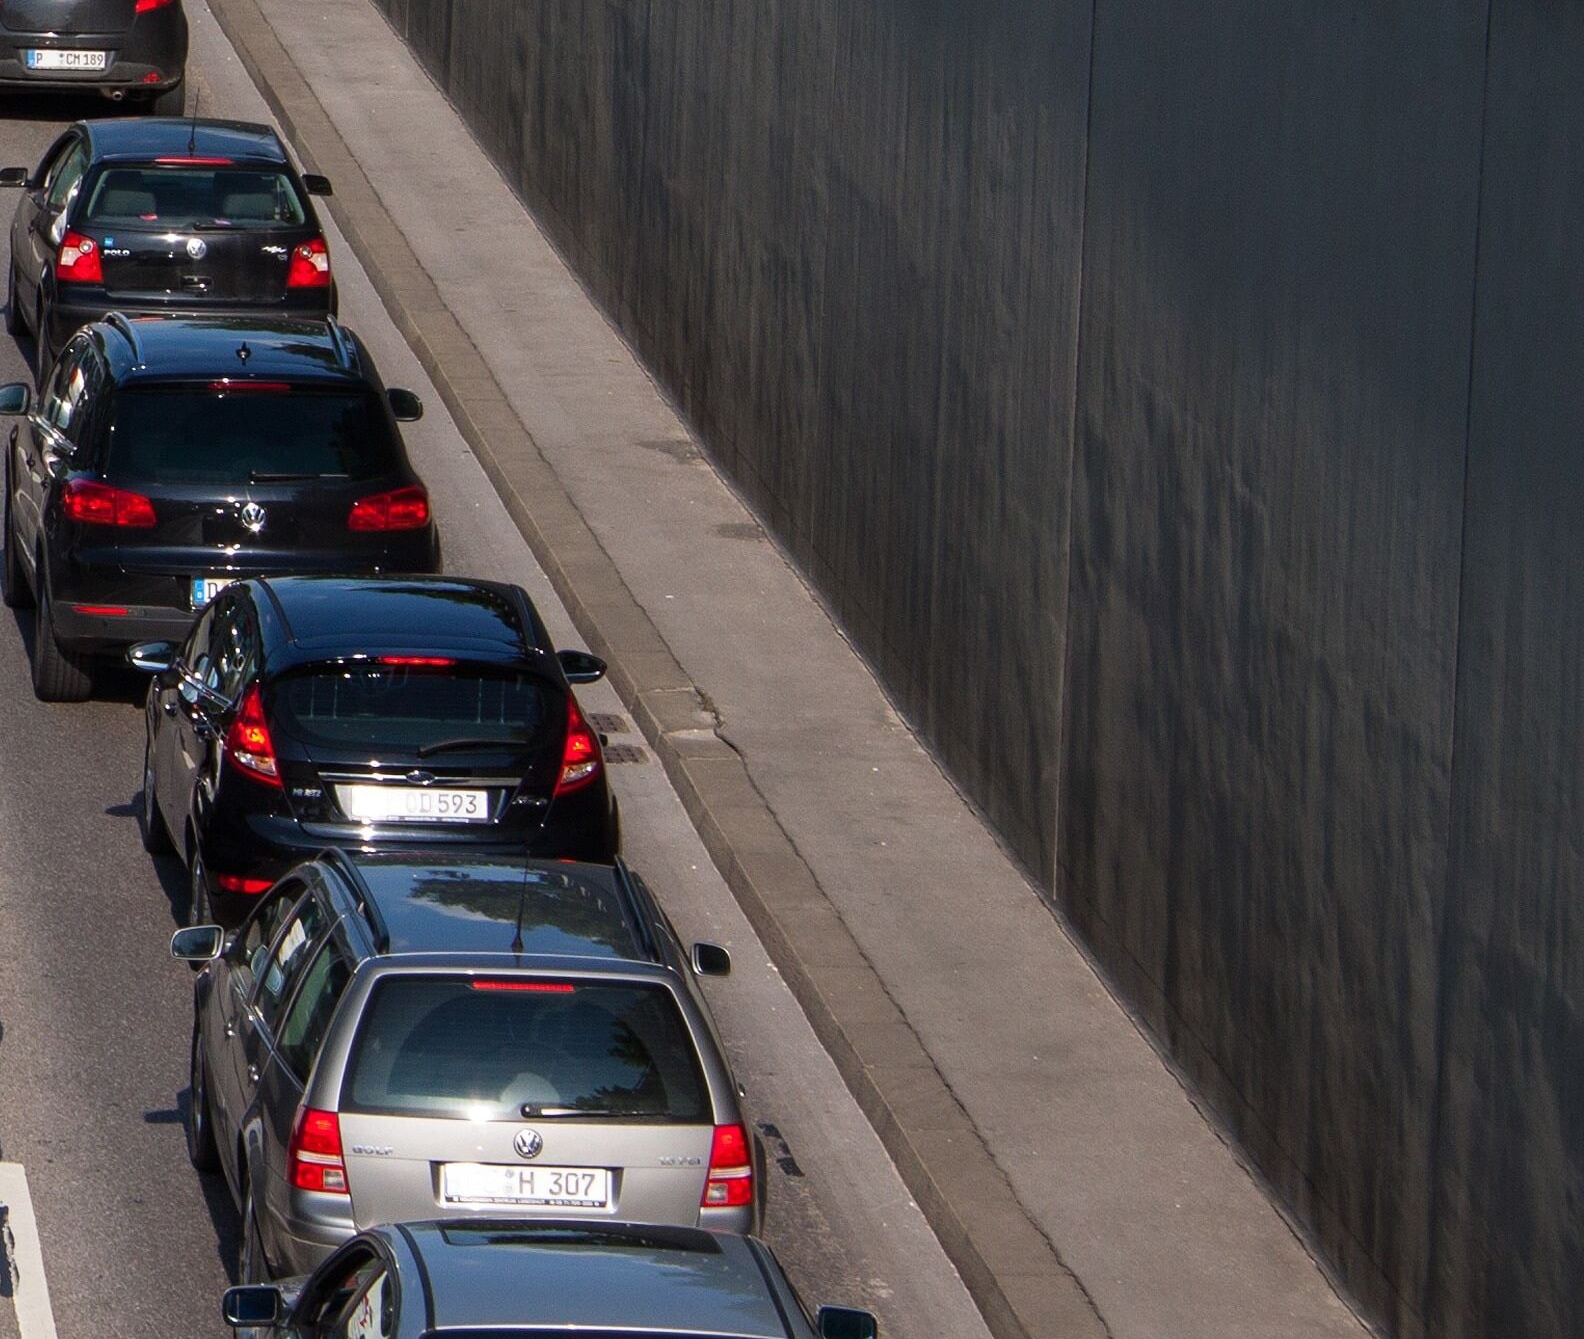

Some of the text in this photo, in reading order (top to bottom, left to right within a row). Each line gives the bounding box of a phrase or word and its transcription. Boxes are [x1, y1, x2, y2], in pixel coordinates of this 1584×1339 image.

[84, 54, 104, 64] 189
[438, 793, 478, 814] 593
[520, 1171, 597, 1196] H 307
